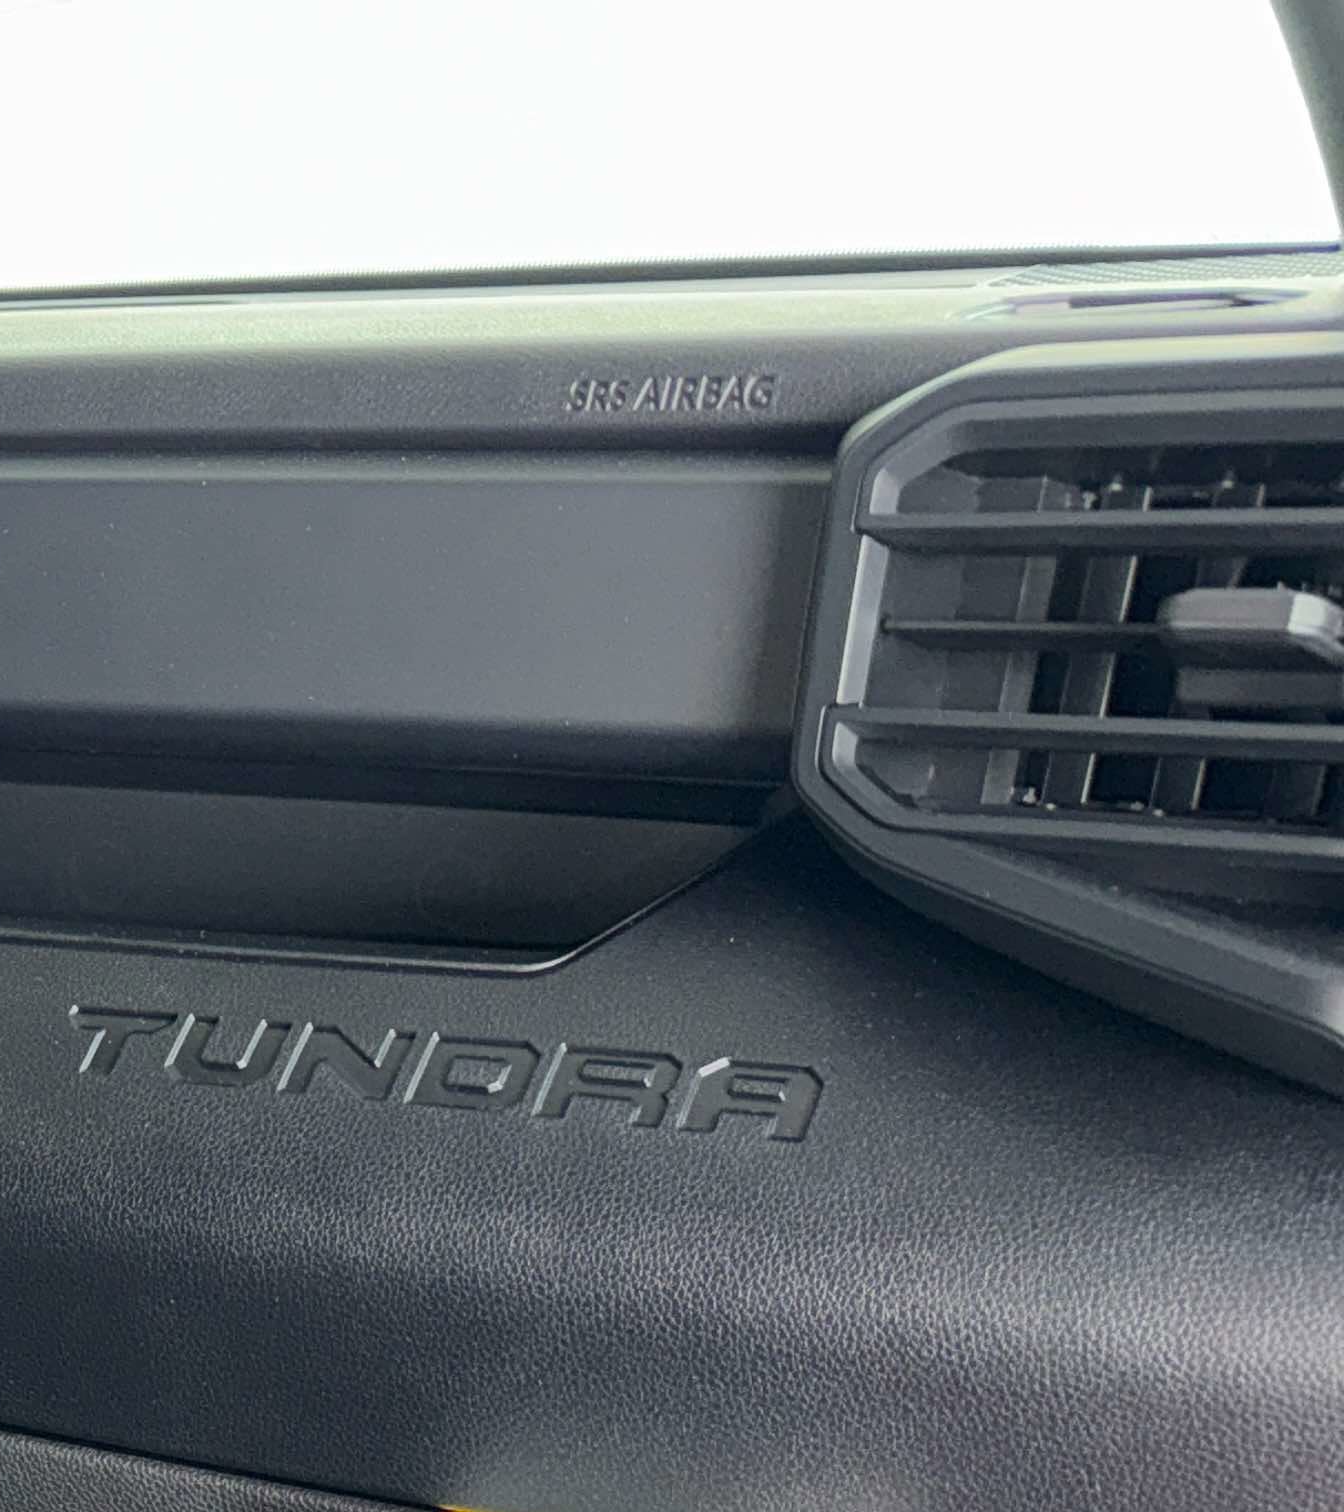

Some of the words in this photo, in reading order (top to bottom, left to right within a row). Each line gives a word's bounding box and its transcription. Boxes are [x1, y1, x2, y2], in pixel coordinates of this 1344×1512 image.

[565, 378, 630, 412] SRS
[633, 375, 775, 412] AIRBAG
[69, 1005, 826, 1144] TUNDRA
